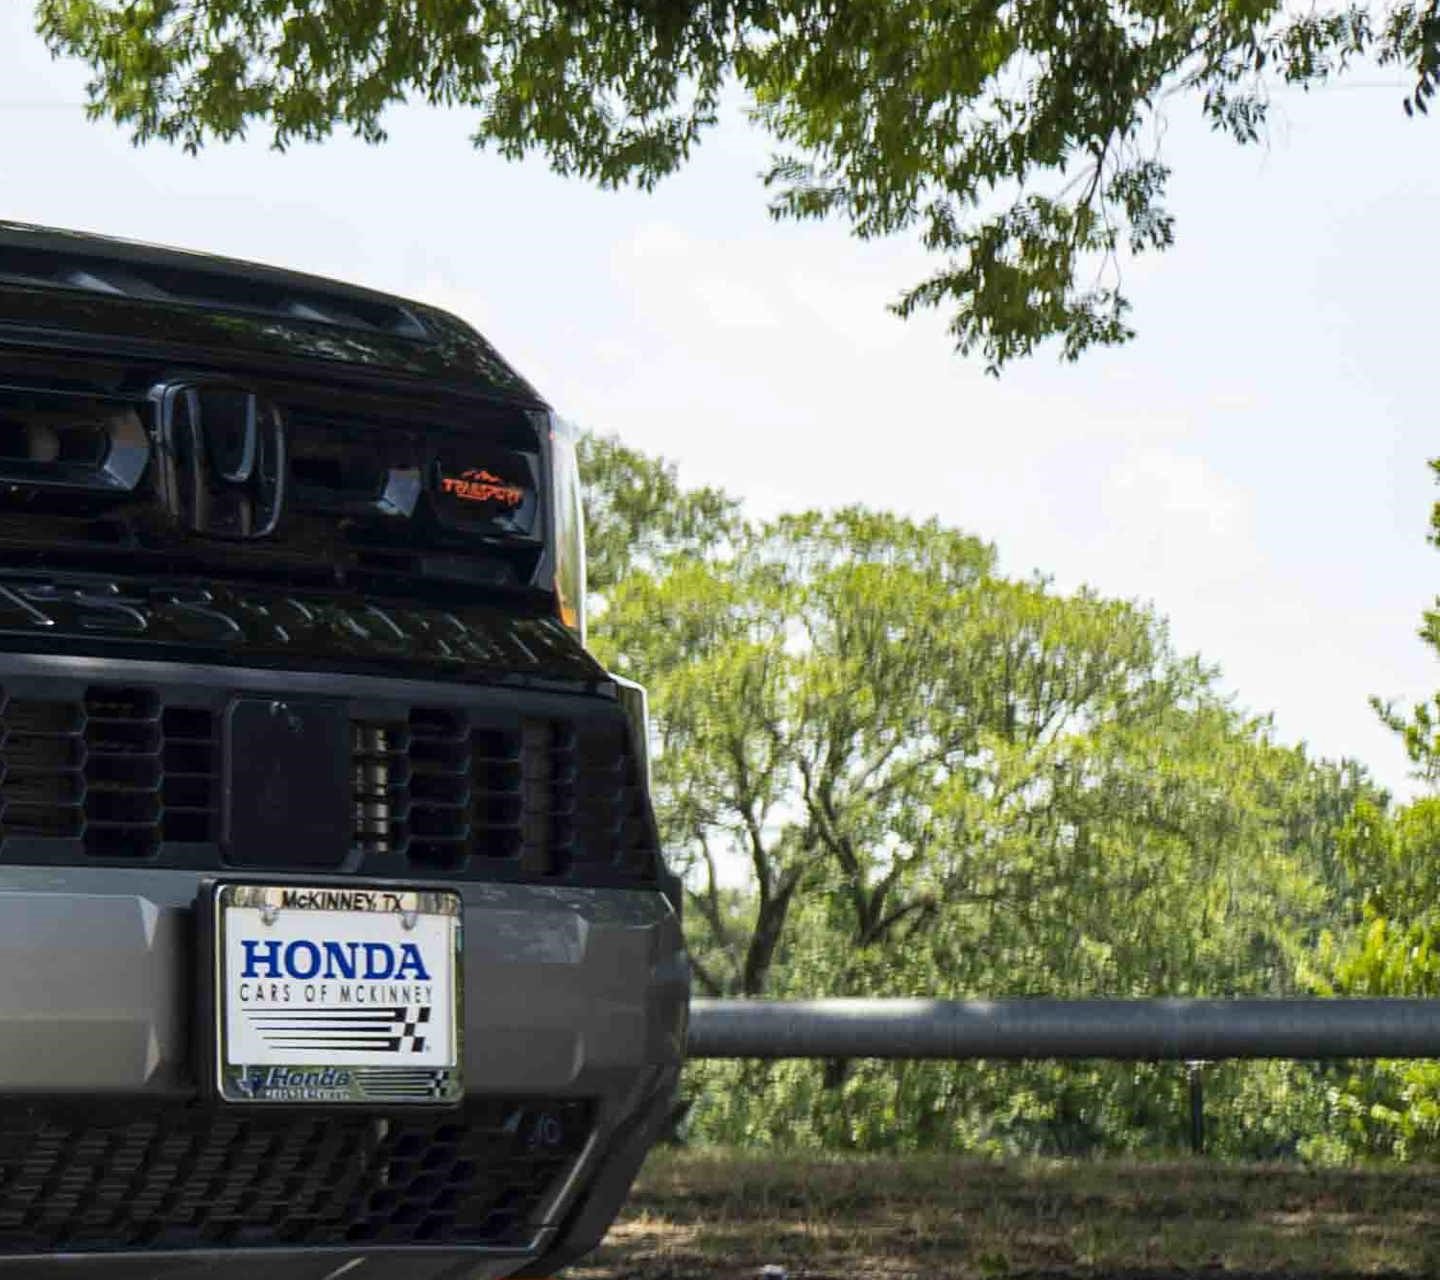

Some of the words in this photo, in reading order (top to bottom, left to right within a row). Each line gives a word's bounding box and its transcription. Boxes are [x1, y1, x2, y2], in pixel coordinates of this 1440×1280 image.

[382, 894, 403, 911] TX
[241, 940, 430, 979] HONDA
[240, 983, 291, 1002] CARS
[304, 984, 328, 1003] OF
[339, 984, 434, 1004] MCKINNEY
[266, 1067, 351, 1086] Honda
